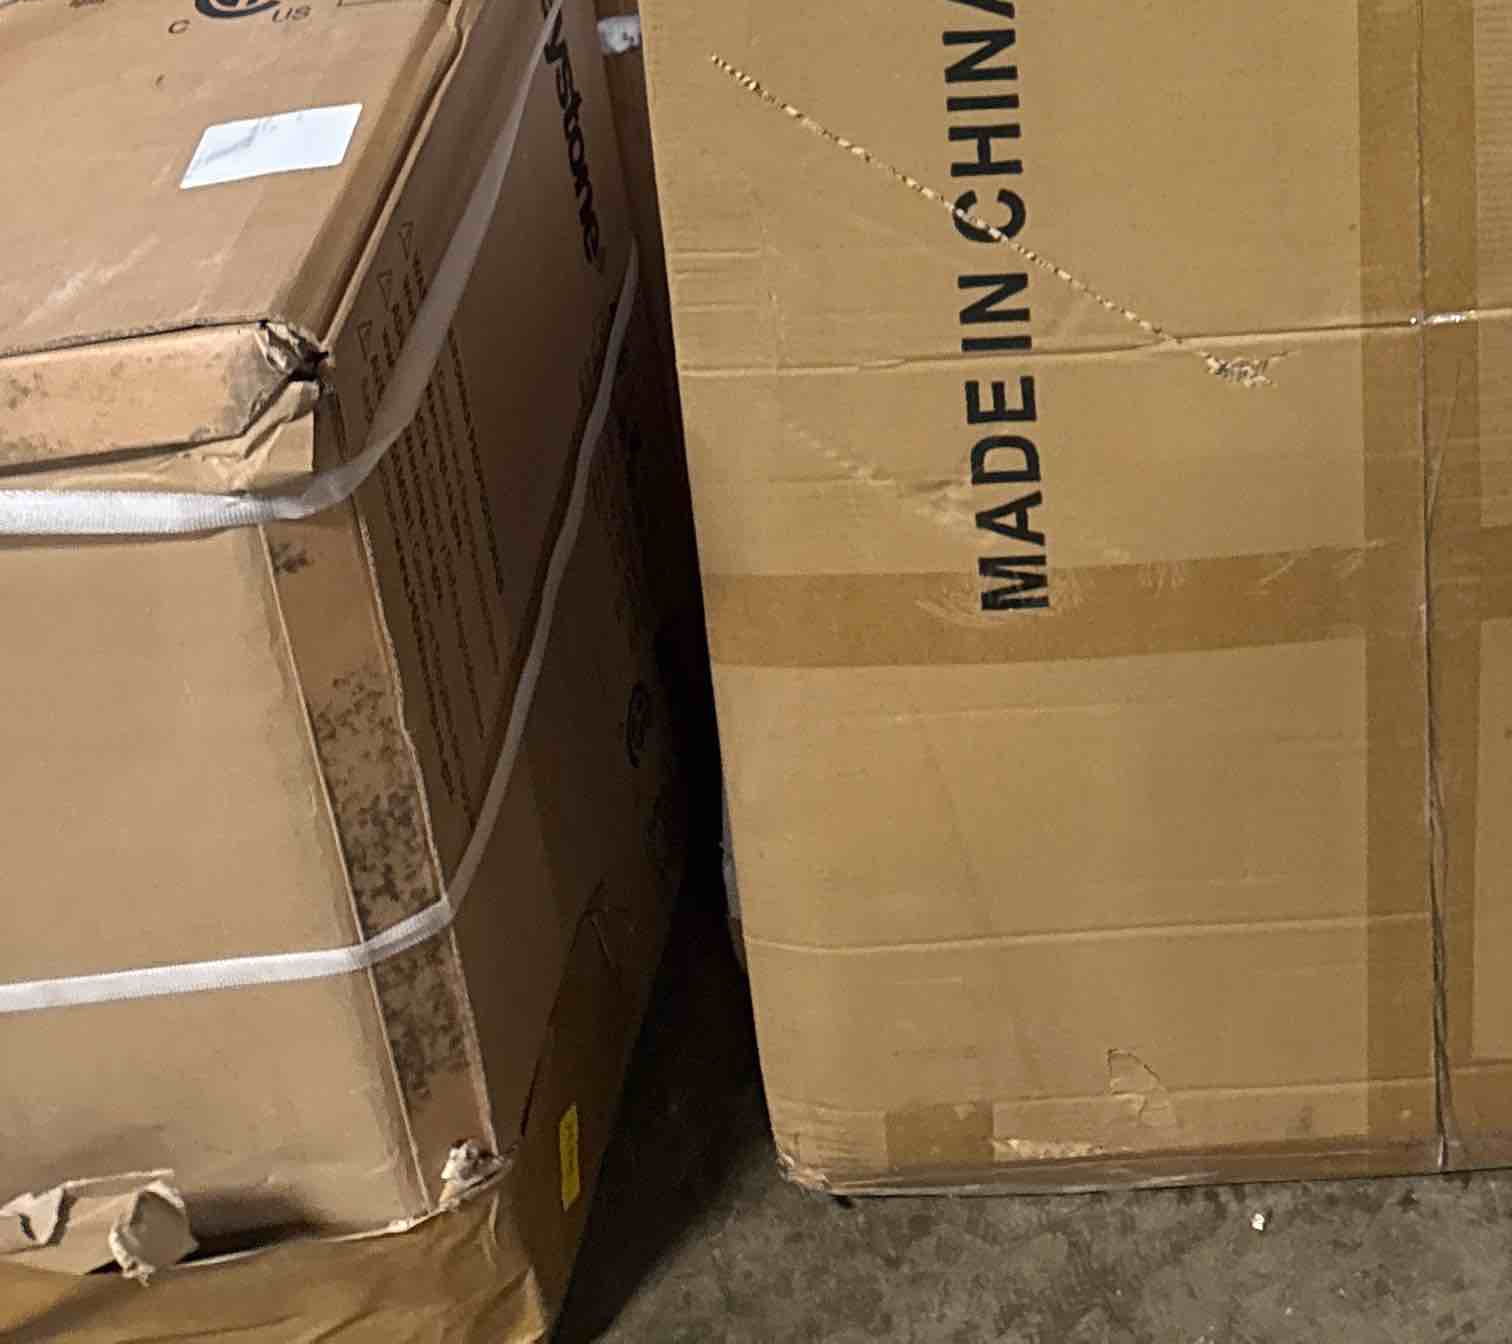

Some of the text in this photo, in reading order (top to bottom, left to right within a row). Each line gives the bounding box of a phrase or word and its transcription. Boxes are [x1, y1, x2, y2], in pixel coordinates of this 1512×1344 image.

[271, 5, 312, 24] US
[957, 273, 1033, 353] IN
[964, 375, 1050, 612] MADE
